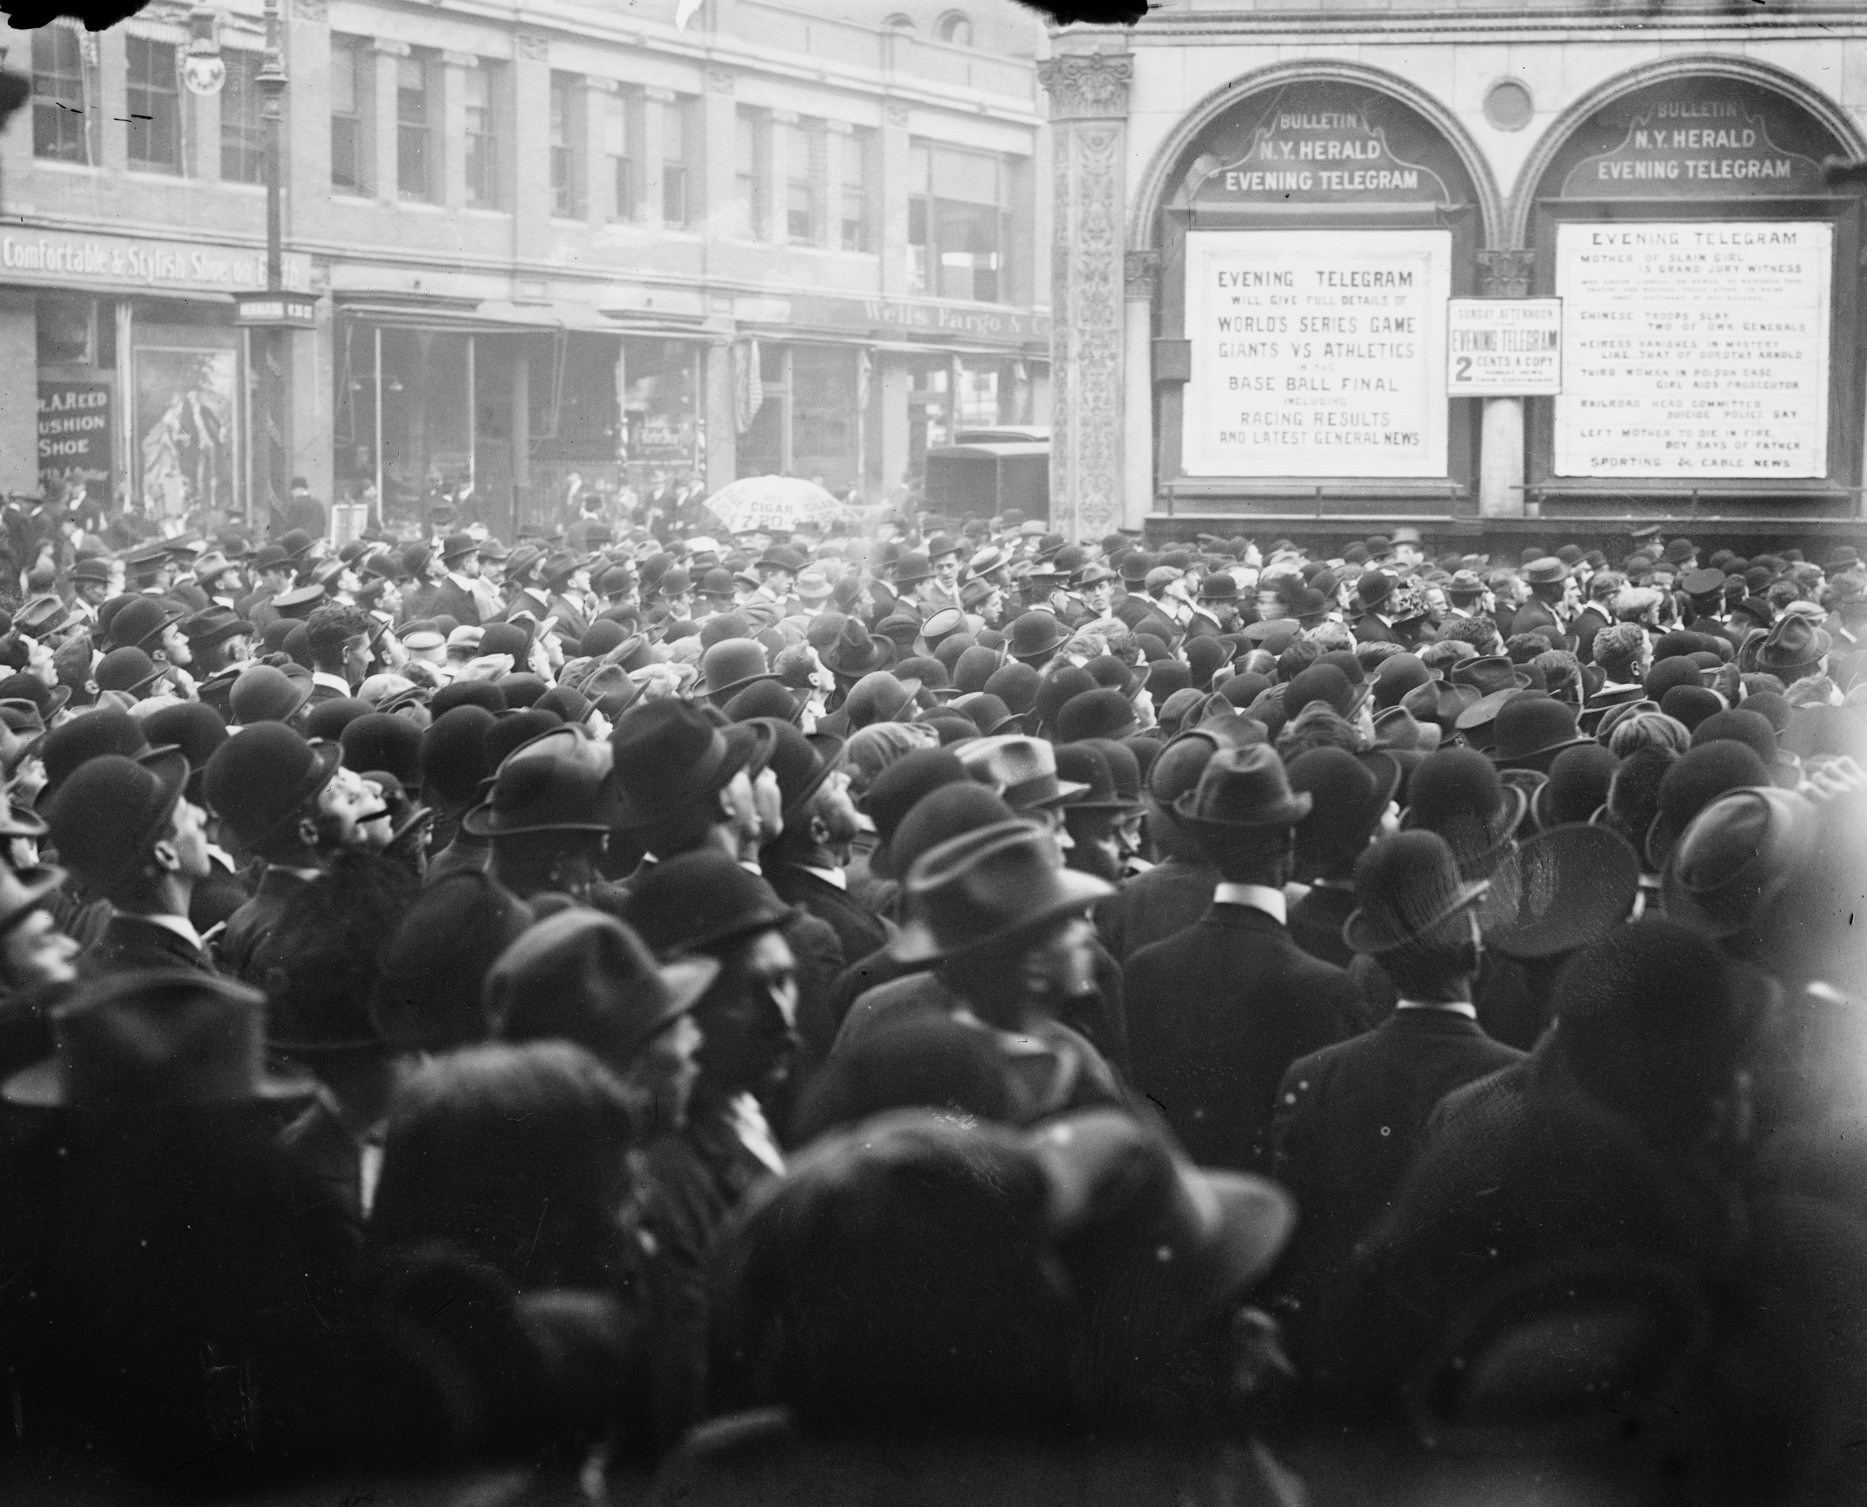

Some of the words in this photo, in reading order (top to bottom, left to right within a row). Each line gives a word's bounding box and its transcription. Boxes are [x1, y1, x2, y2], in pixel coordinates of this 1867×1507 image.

[1657, 101, 1737, 117] BULLETIN
[1279, 112, 1358, 129] BULLETIN
[1673, 129, 1755, 149] HERALD
[1300, 140, 1381, 160] HERALD
[1599, 160, 1679, 180] EVENING
[1686, 159, 1791, 179] TELEGRAM
[1225, 172, 1312, 191] EVENING
[1319, 171, 1418, 190] TELEGRAM
[1592, 232, 1680, 246] EVENING
[1694, 232, 1798, 245] TELEGRAM
[3, 236, 107, 273] Comfortable
[112, 249, 125, 275] &
[128, 245, 186, 283] Stylish
[191, 251, 228, 281] Shoe
[233, 261, 252, 283] on
[257, 256, 300, 289] Eth
[1580, 254, 1634, 263] MOTHER
[1645, 254, 1660, 263] OF
[1669, 254, 1706, 263] SLAIN
[1714, 253, 1745, 263] GIRL
[1638, 265, 1652, 274] IS
[1659, 264, 1701, 274] GRAND
[1708, 264, 1740, 274] JURY
[1748, 264, 1802, 274] WITNESS
[1217, 271, 1294, 288] EVENING
[1316, 270, 1414, 288] TELEGRAM
[1231, 296, 1262, 306] WILL
[1270, 295, 1298, 305] GIVE
[1306, 295, 1336, 306] FULL
[1341, 295, 1389, 306] DETAILS
[1394, 295, 1408, 305] OF
[864, 301, 929, 325] Wells
[938, 306, 1000, 335] Fargo
[1580, 311, 1633, 321] CHINESE
[1644, 311, 1689, 321] TROOPS
[1699, 311, 1729, 321] SLAY
[1218, 316, 1288, 333] WORLD'S
[1299, 316, 1358, 334] SERIES
[1369, 316, 1416, 334] GAME
[1648, 323, 1672, 331] TWO
[1682, 323, 1697, 331] OF
[1707, 323, 1734, 332] OWN
[1743, 323, 1806, 332] GENERALS
[1452, 329, 1497, 352] EVENING
[1502, 329, 1557, 352] TELEGRAM
[1580, 340, 1632, 349] HEIRESS
[1639, 340, 1698, 349] VANISHES
[1708, 340, 1719, 349] IN
[1726, 340, 1780, 349] MYSTERY
[1218, 342, 1279, 359] GIANTS
[1291, 342, 1312, 358] VS
[1324, 342, 1414, 359] ATHLETICS
[1601, 351, 1629, 360] LIKE
[1640, 351, 1670, 360] THAT
[1677, 351, 1691, 360] OF
[1699, 351, 1752, 360] DOROTHY
[1758, 351, 1803, 360] ARNOLD
[1455, 356, 1472, 382] 2
[1476, 356, 1511, 367] CENTS
[1515, 356, 1521, 367] A
[1525, 356, 1553, 367] COPY
[1580, 369, 1616, 377] THIRD
[1626, 369, 1670, 377] WOMAN
[1676, 369, 1687, 377] IN
[1694, 369, 1737, 378] POISON
[1743, 369, 1772, 377] CASE
[1229, 376, 1276, 391] BASE
[1286, 377, 1331, 391] BALL
[1342, 377, 1399, 392] FINAL
[1656, 381, 1683, 390] GIRL
[1693, 381, 1719, 390] AIDS
[1726, 381, 1799, 390] PROSECUTOR
[1283, 397, 1348, 407] INCLUDING
[1580, 399, 1641, 408] RAILROAD
[1652, 400, 1684, 408] HEAD
[1691, 400, 1761, 408] COMMITTED
[1241, 412, 1303, 427] RACING
[1314, 412, 1390, 427] RESULTS
[1724, 411, 1764, 419] POLICE
[1773, 411, 1798, 419] SAY
[1219, 431, 1246, 444] AND
[1253, 432, 1307, 445] LATEST
[1314, 432, 1380, 445] GENERAL
[1384, 432, 1420, 446] NEWS
[1580, 429, 1613, 438] LEFT
[1621, 429, 1671, 438] MOTHER
[1679, 429, 1693, 438] TO
[1699, 429, 1718, 438] DIE
[1726, 429, 1737, 438] IN
[38, 438, 90, 457] SHOE
[1665, 441, 1688, 450] BOY
[1696, 441, 1727, 450] SAYS
[1734, 441, 1749, 450] OF
[1756, 441, 1801, 450] FATHER
[1590, 457, 1662, 467] SPORTING
[1701, 458, 1744, 468] CABLE
[1753, 459, 1791, 468] NEWS
[751, 501, 794, 514] CIGAR
